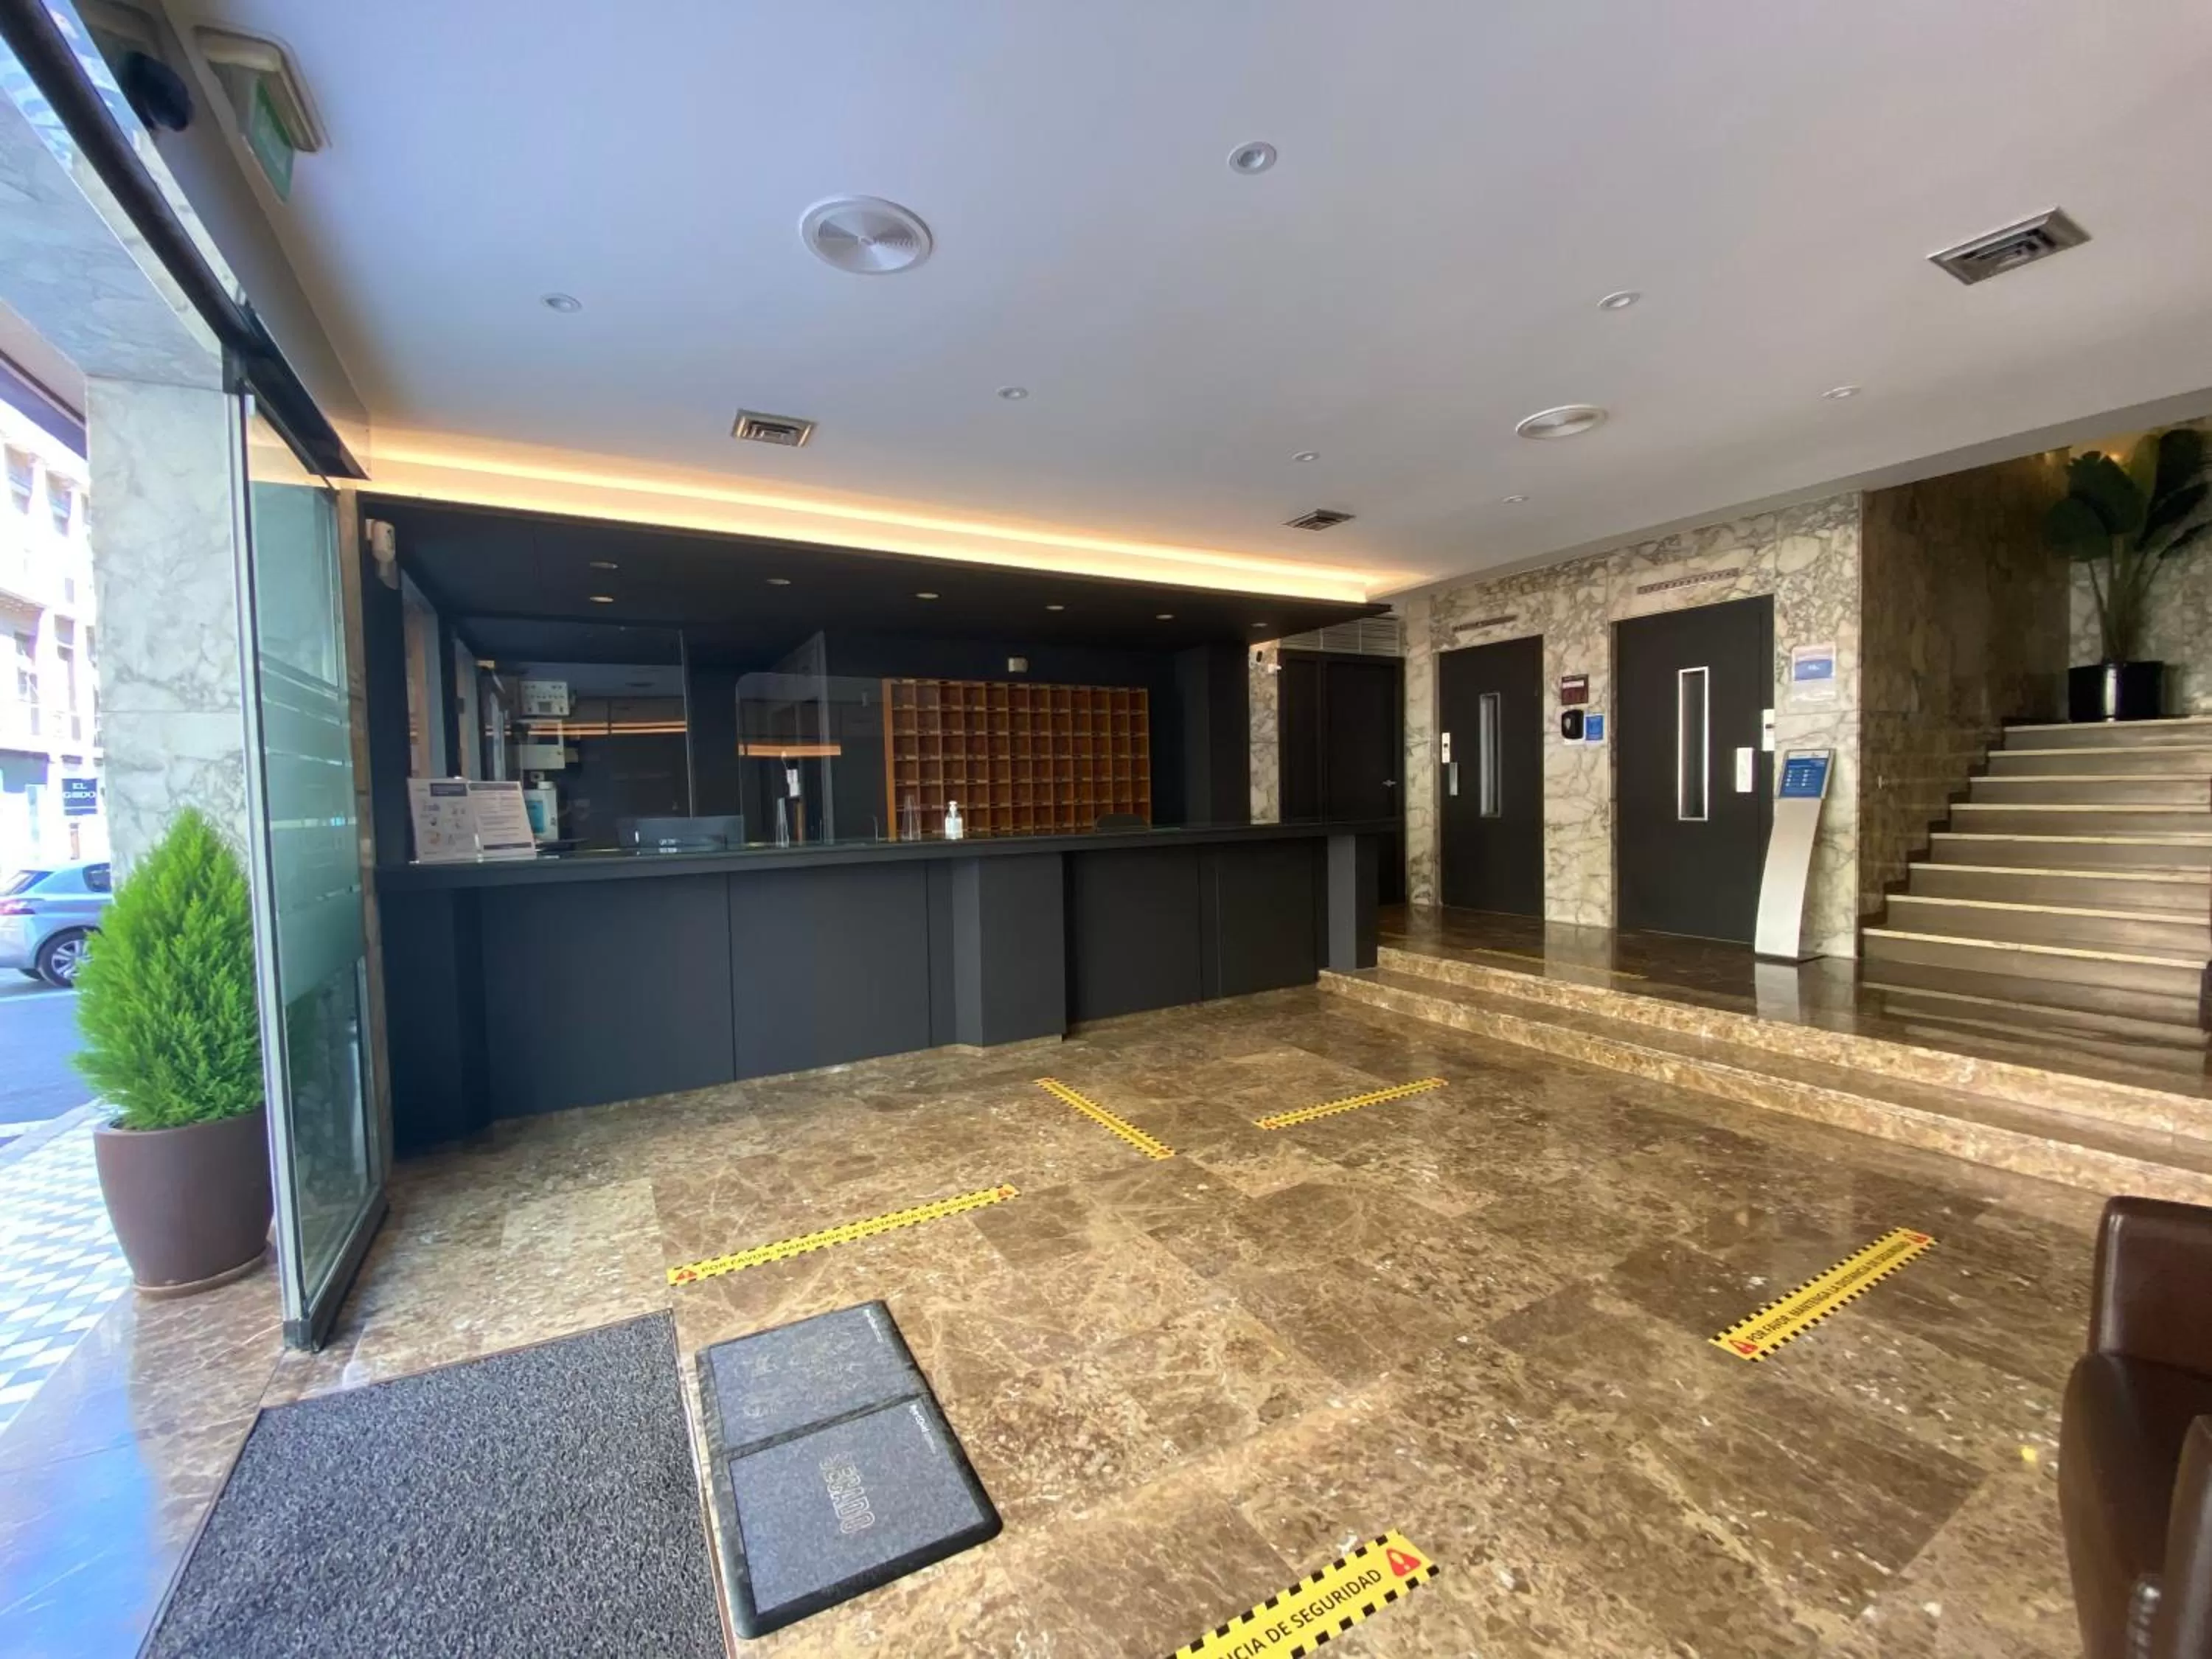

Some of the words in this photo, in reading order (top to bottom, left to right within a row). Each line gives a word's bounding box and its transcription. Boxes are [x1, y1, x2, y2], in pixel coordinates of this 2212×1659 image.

[700, 1262, 727, 1273] POR
[776, 1231, 844, 1253] MANTENGA
[1745, 1329, 1768, 1343] POR
[1788, 1290, 1832, 1317] MANTENGA
[1218, 1638, 1267, 1659] CIA
[1265, 1621, 1293, 1644] DE
[1290, 1569, 1382, 1629] SEGURIDAD
